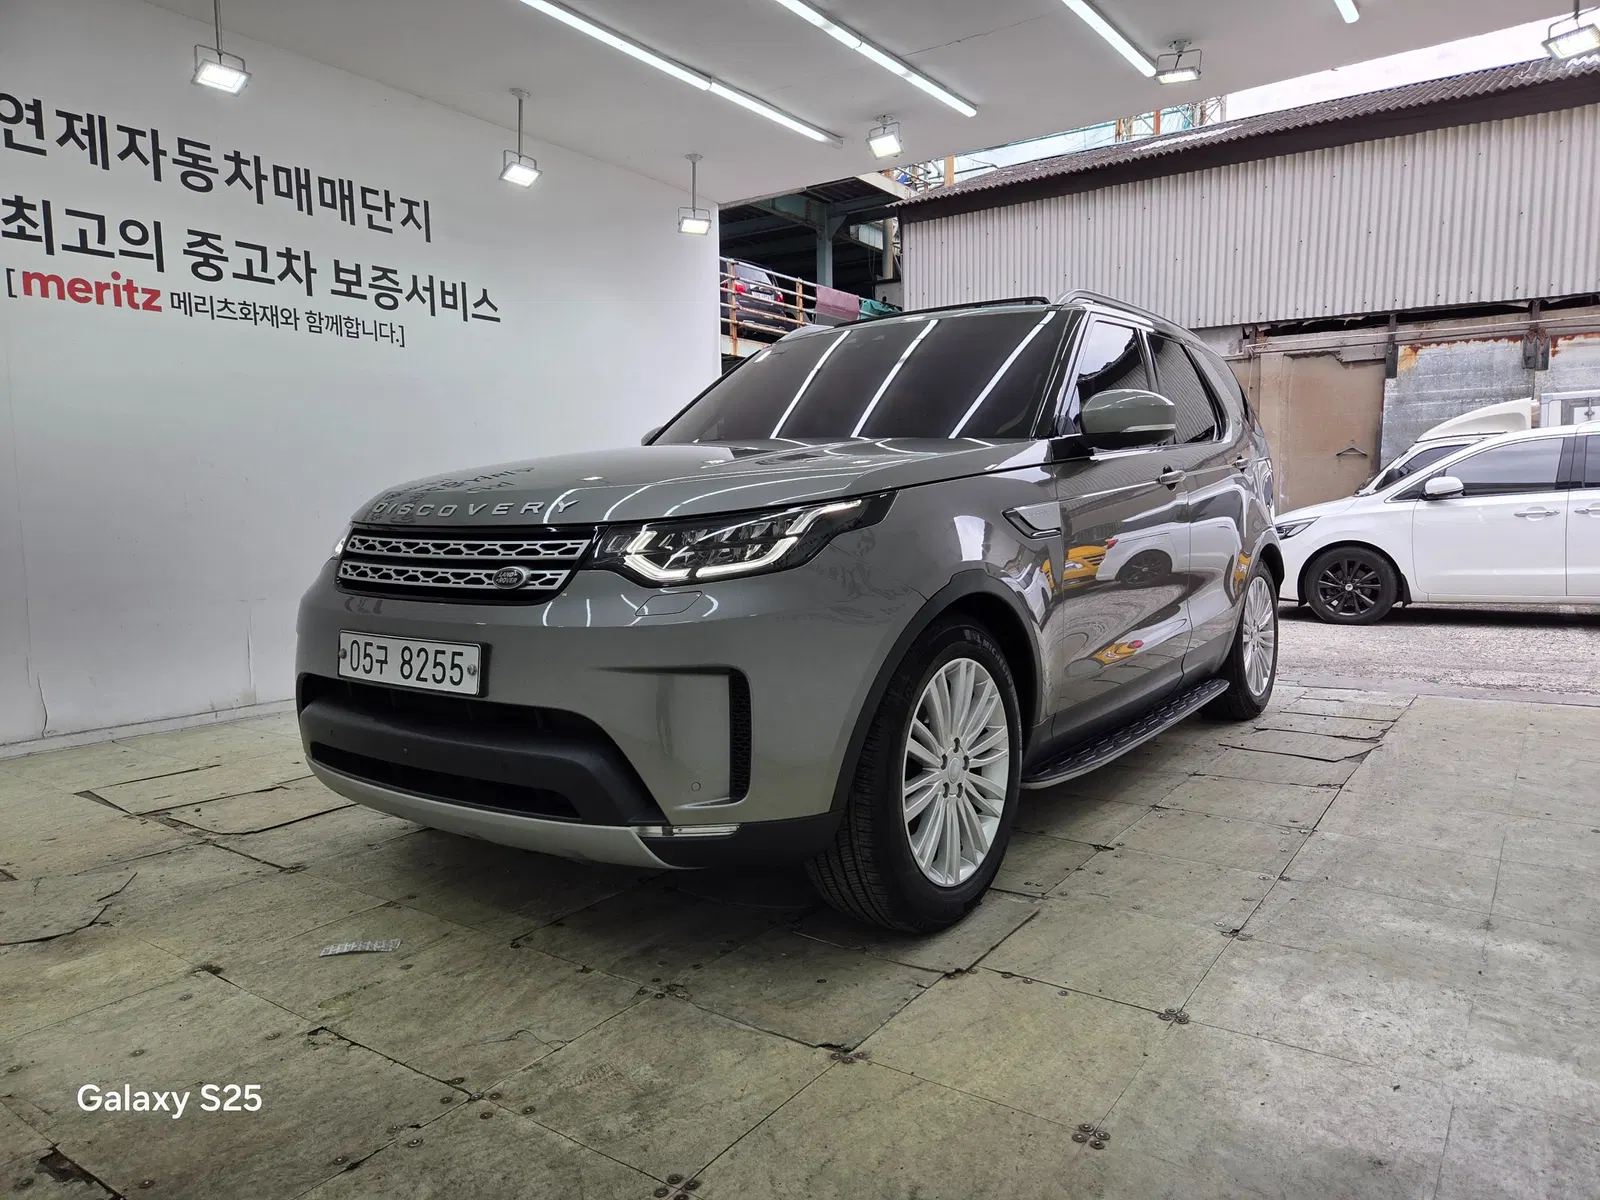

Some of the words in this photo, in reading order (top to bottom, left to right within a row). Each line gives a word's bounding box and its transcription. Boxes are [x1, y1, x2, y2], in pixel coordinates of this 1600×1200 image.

[0, 92, 431, 243] 연제자동차매매단지
[2, 195, 165, 273] 최고의
[183, 228, 317, 297] 중고차
[331, 258, 501, 323] 보증서비스
[170, 291, 300, 331] 메리츠화재와
[305, 310, 405, 348] 함께합니다.]
[371, 500, 580, 518] DISCOVERY
[350, 639, 388, 675] 05구
[400, 645, 464, 686] 8255
